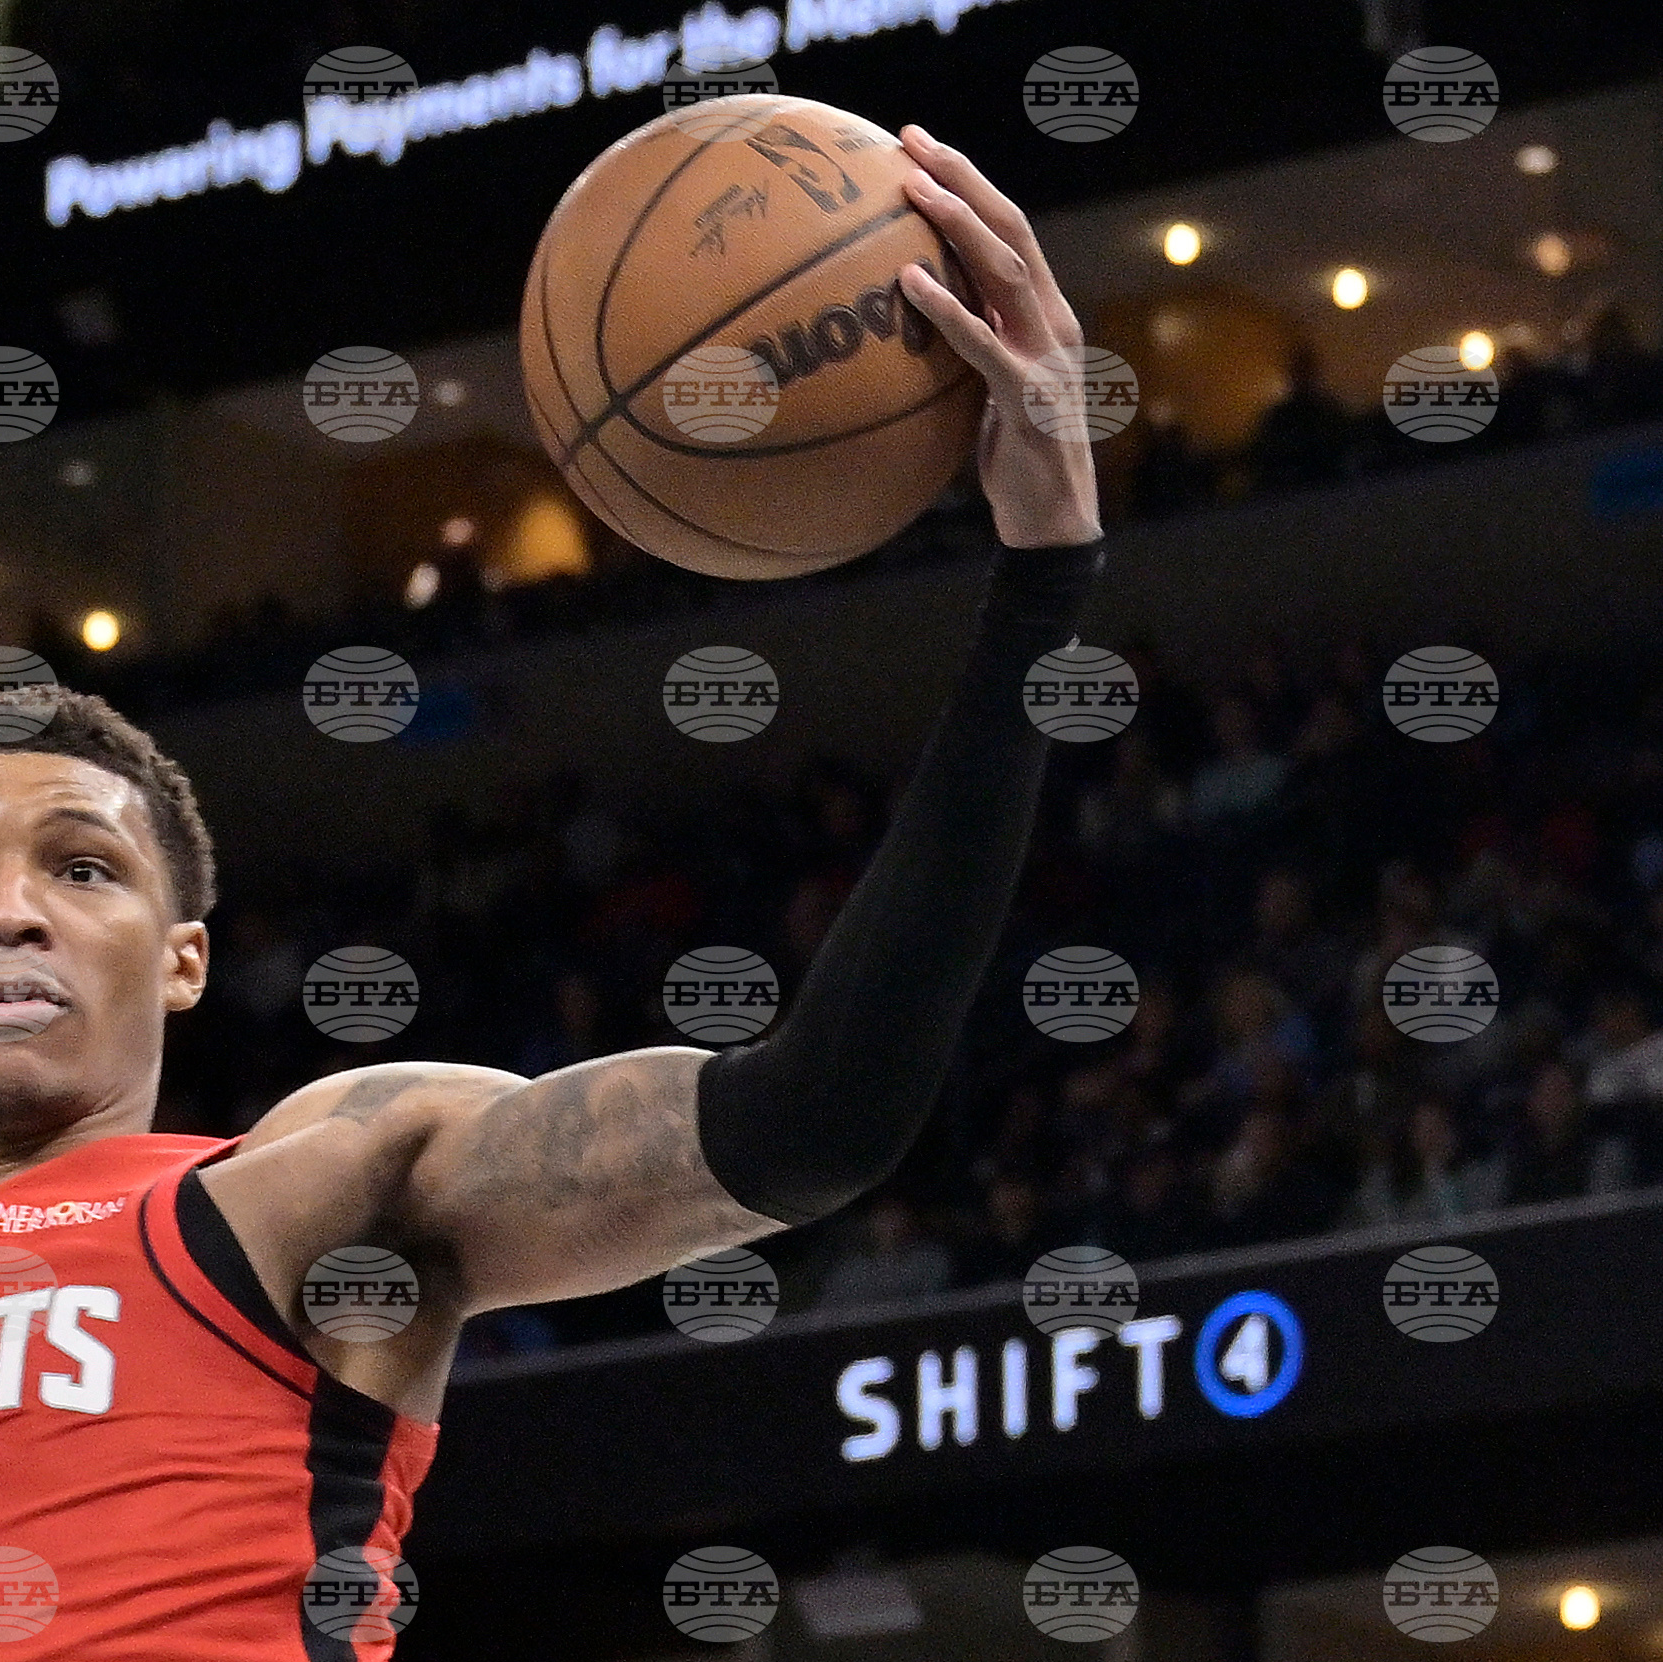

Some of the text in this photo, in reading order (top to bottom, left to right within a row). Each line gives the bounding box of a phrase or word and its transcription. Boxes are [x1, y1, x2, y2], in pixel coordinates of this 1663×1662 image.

[45, 119, 301, 227] Powering
[305, 50, 583, 164] Payments
[589, 24, 678, 98] for
[681, 0, 780, 75] the
[835, 1313, 1183, 1462] SHIFT
